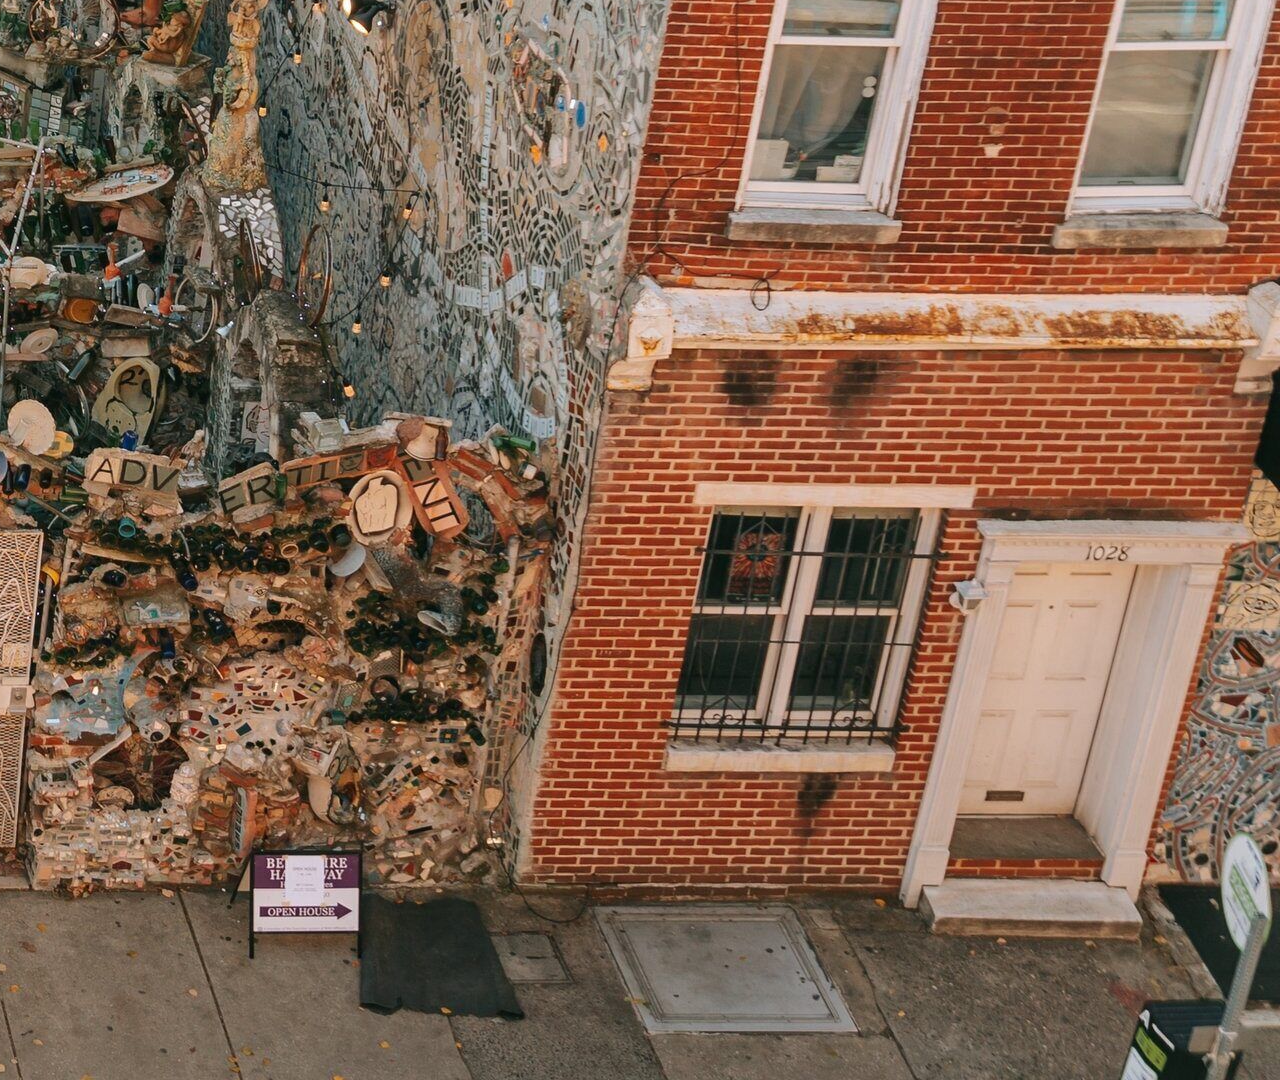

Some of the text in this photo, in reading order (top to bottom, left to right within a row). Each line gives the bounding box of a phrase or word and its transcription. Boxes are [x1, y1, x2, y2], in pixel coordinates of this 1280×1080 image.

[1085, 544, 1130, 562] 1028
[267, 907, 336, 916] OPEN HOUSE
